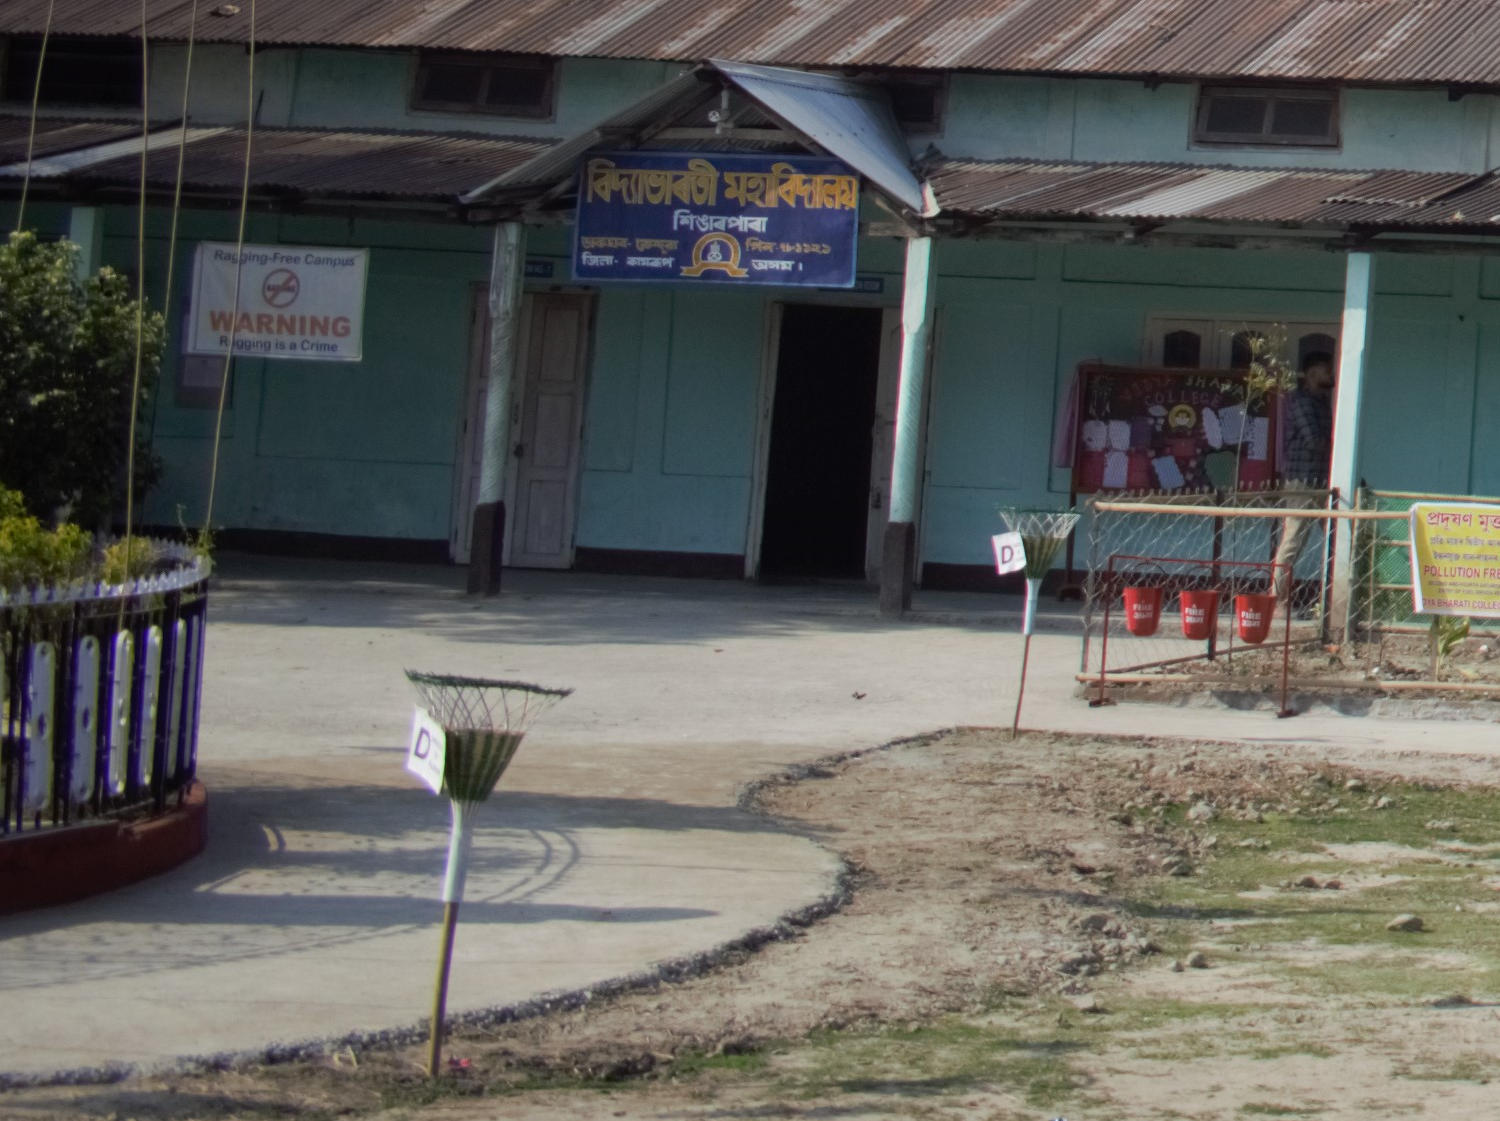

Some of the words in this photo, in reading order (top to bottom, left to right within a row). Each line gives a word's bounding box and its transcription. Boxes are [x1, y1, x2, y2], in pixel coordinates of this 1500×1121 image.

[304, 254, 355, 268] Campus
[209, 310, 351, 338] WARNING
[275, 339, 286, 350] is
[289, 341, 297, 350] a
[301, 339, 339, 352] Crime
[1002, 545, 1014, 564] D
[1424, 565, 1480, 579] POLLUTION
[1438, 599, 1471, 608] BHARATI
[414, 728, 430, 759] D
